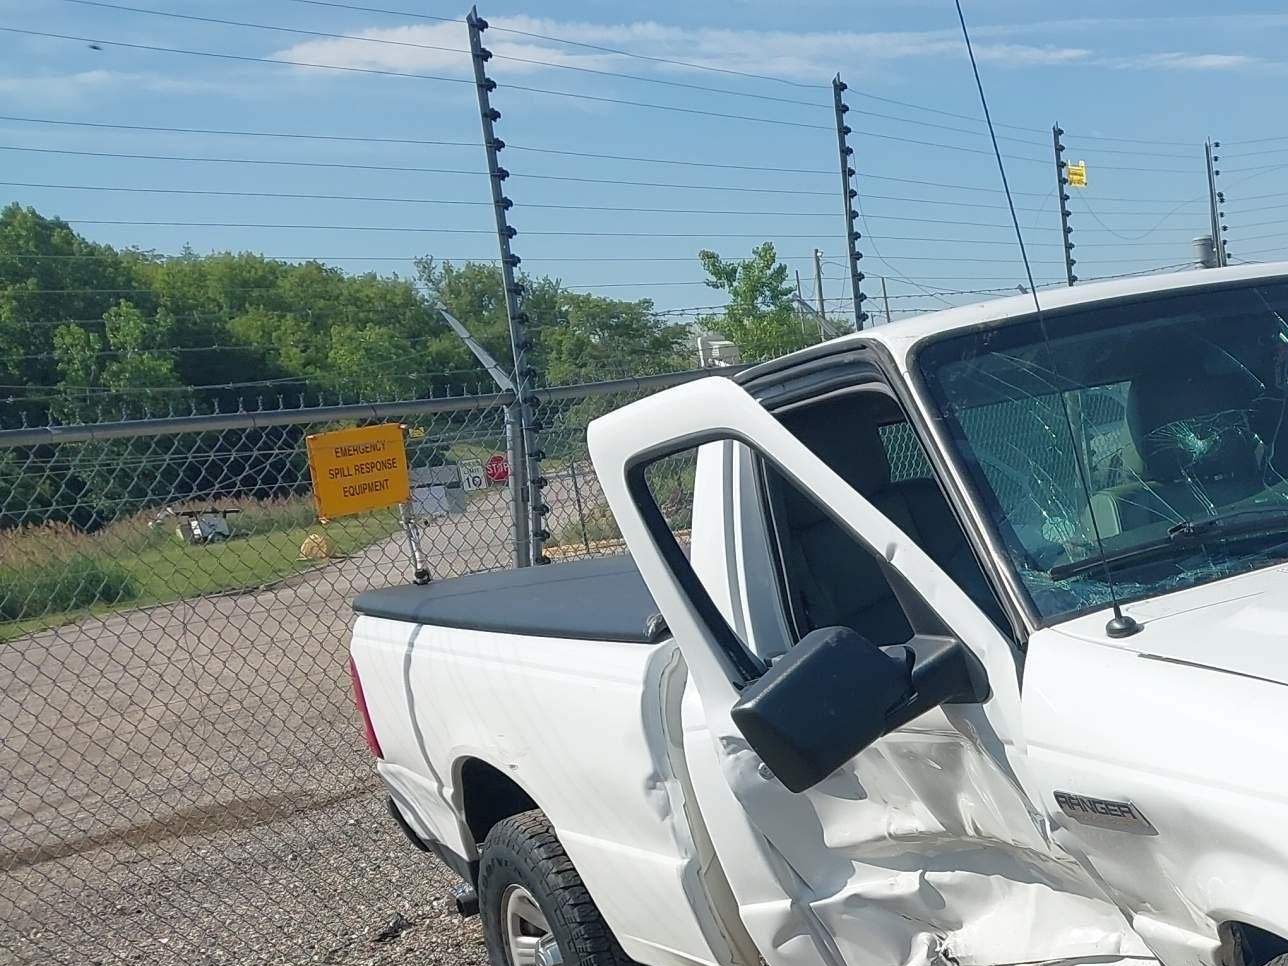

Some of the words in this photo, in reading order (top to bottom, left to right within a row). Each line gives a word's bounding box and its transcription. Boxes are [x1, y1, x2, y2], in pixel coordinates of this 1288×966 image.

[335, 440, 386, 459] EMERGENCY
[328, 463, 353, 480] SPILL
[354, 458, 398, 477] RESPONSE
[486, 463, 509, 475] STOP
[343, 478, 390, 498] EQUIPMENT
[465, 475, 482, 489] 10
[1055, 793, 1138, 819] RANGER
